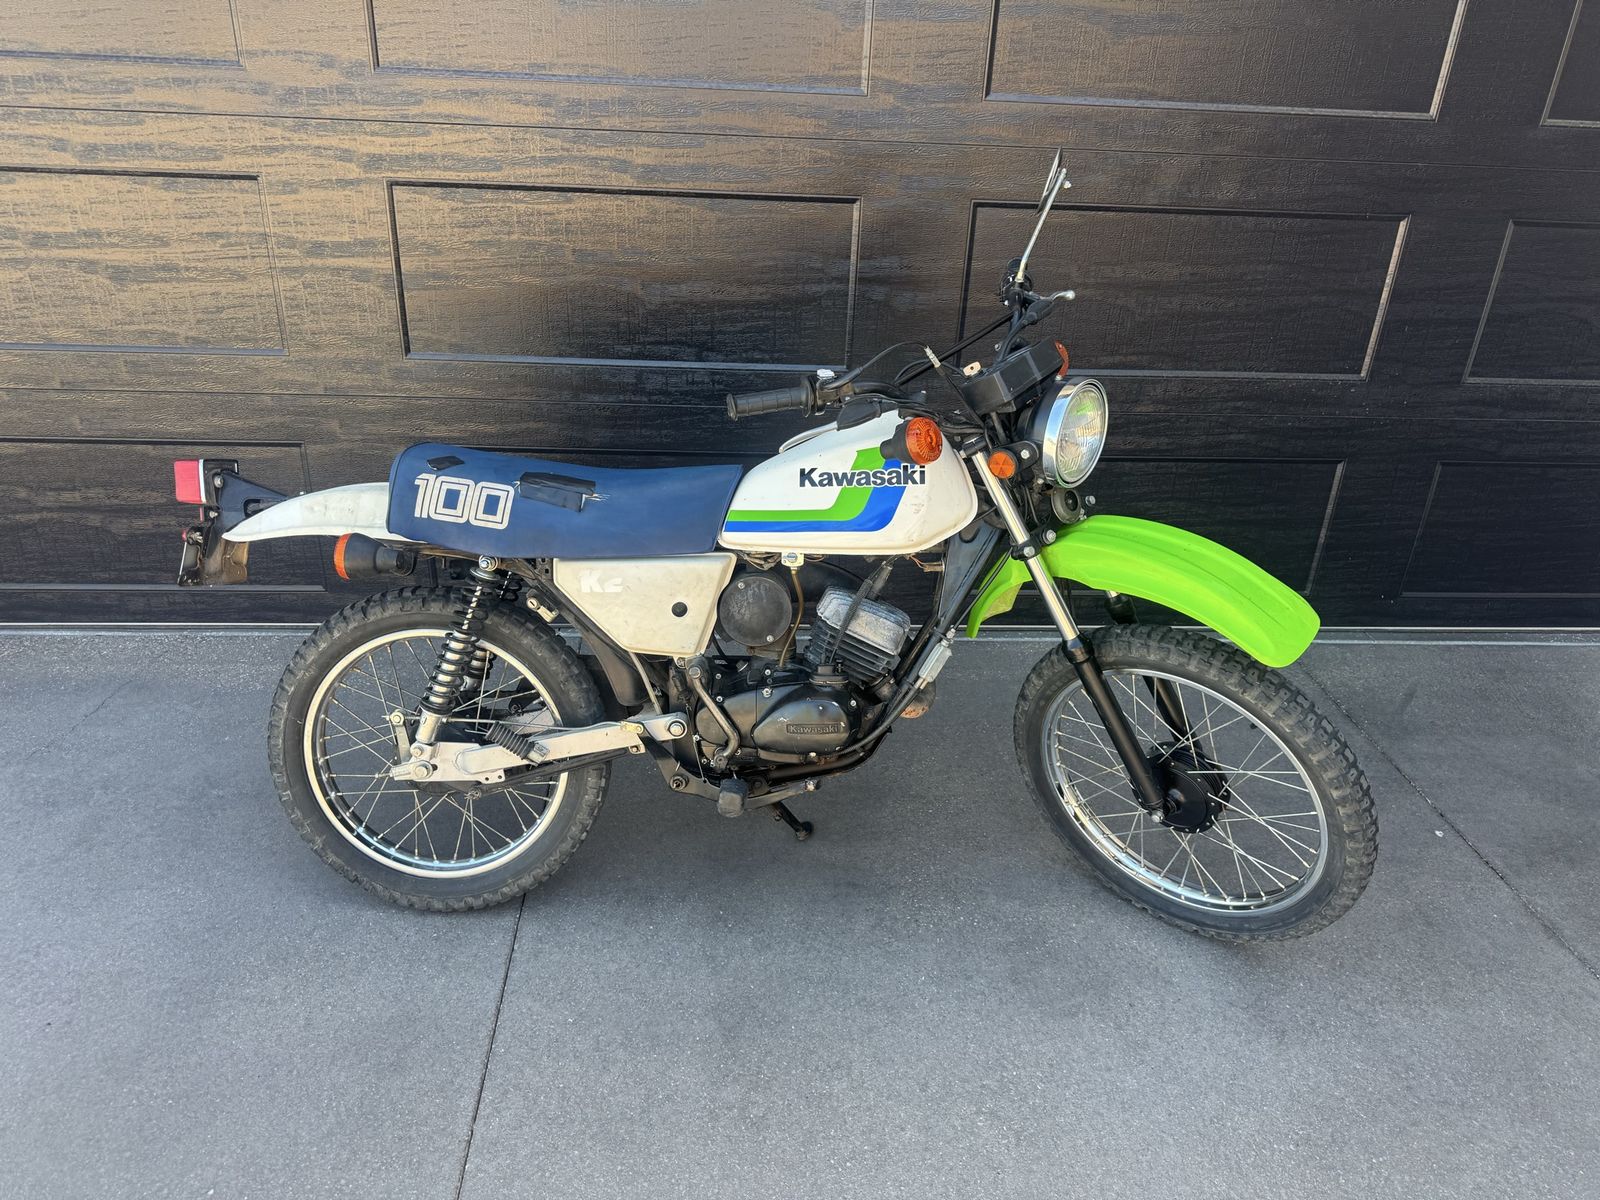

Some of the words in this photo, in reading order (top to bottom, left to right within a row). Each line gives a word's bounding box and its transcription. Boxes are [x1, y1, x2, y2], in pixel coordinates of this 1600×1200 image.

[799, 464, 926, 488] Kawasaki
[414, 473, 514, 530] 100
[790, 725, 838, 733] Kawasaki
